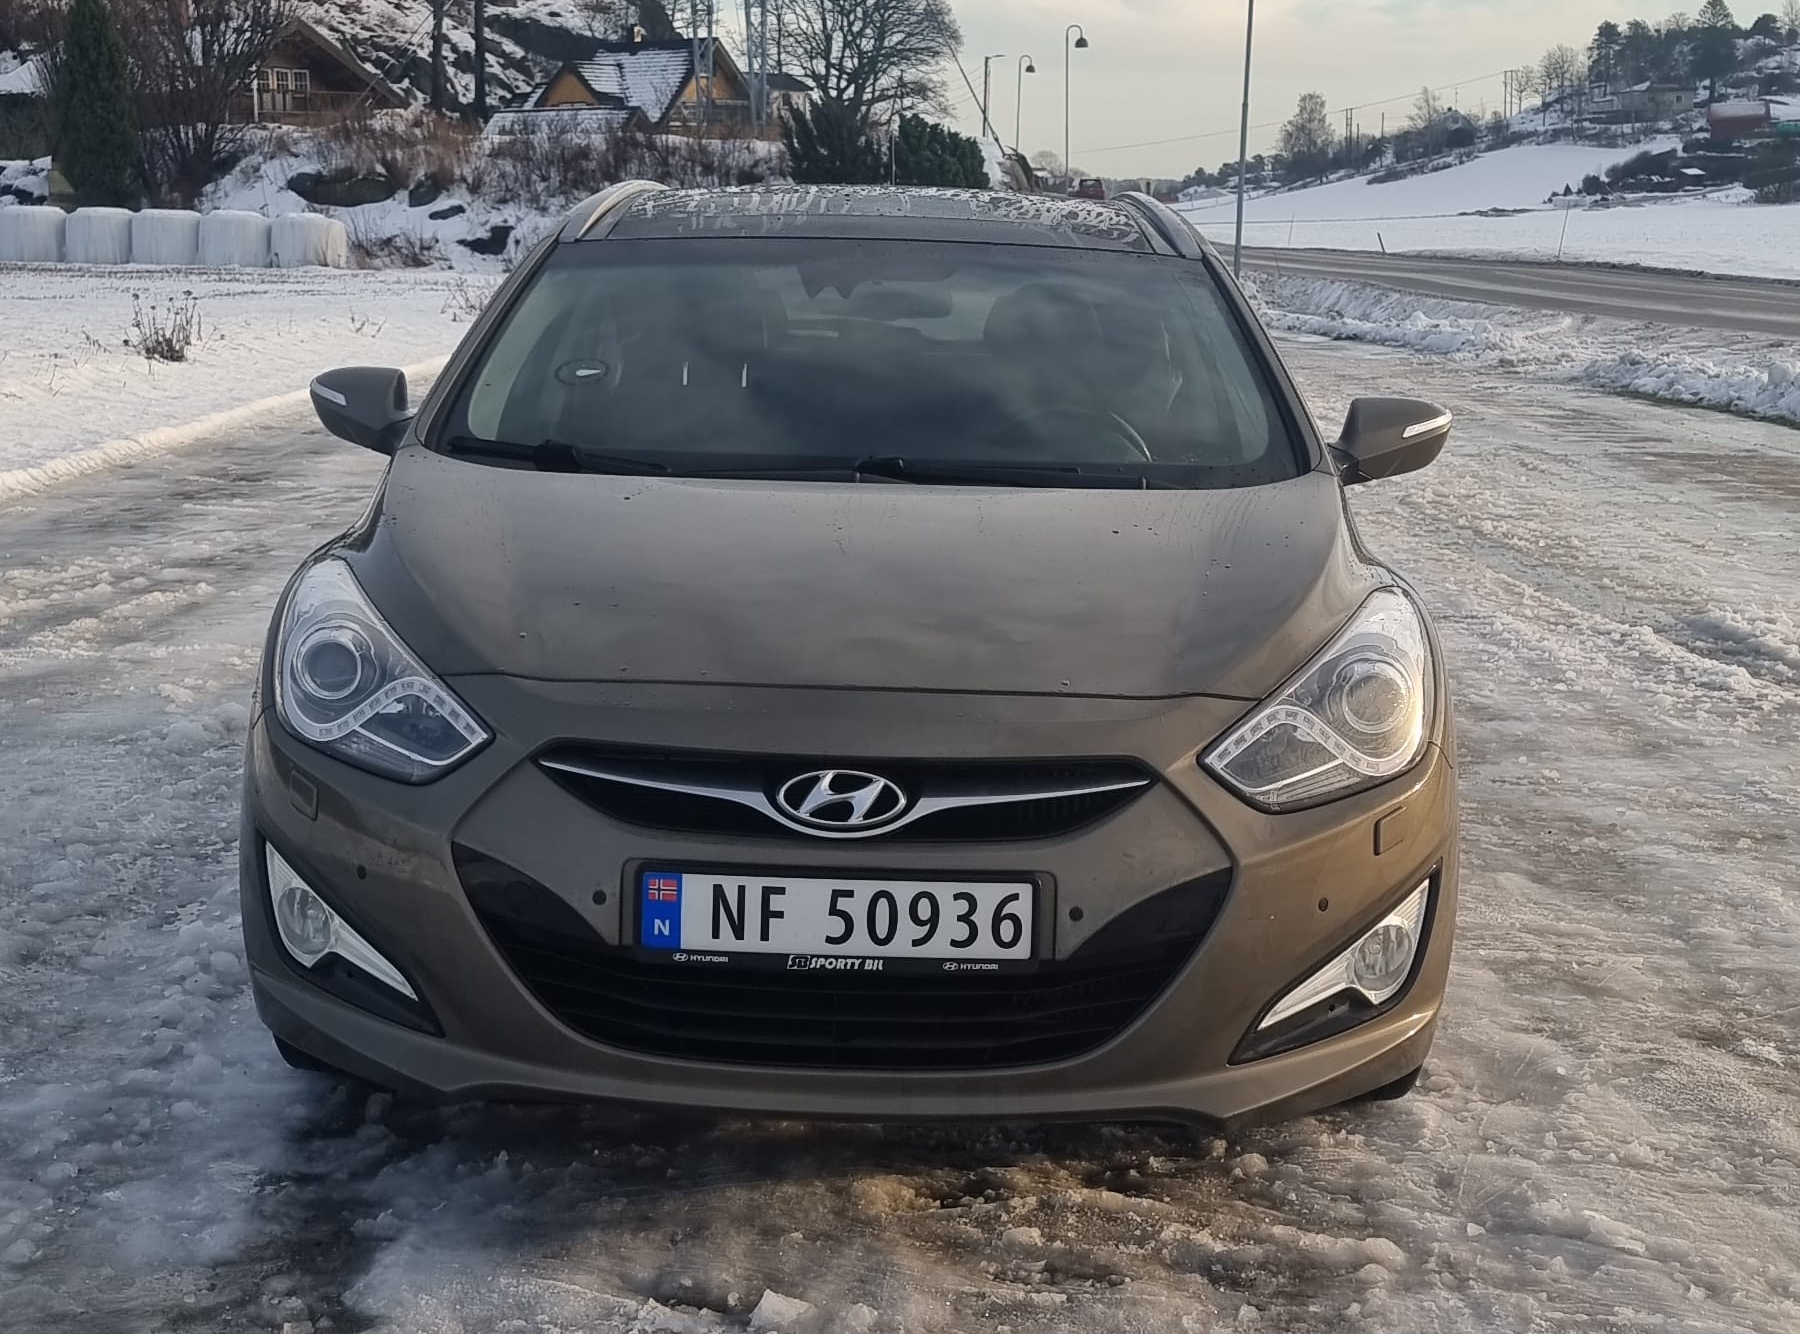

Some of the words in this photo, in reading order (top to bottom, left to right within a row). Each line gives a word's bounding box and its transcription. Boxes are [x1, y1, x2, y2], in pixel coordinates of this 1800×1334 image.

[712, 884, 786, 941] NF
[825, 889, 1023, 949] 50936
[654, 919, 669, 935] N
[690, 954, 729, 962] HYUNDAI
[809, 957, 862, 970] SPORTY
